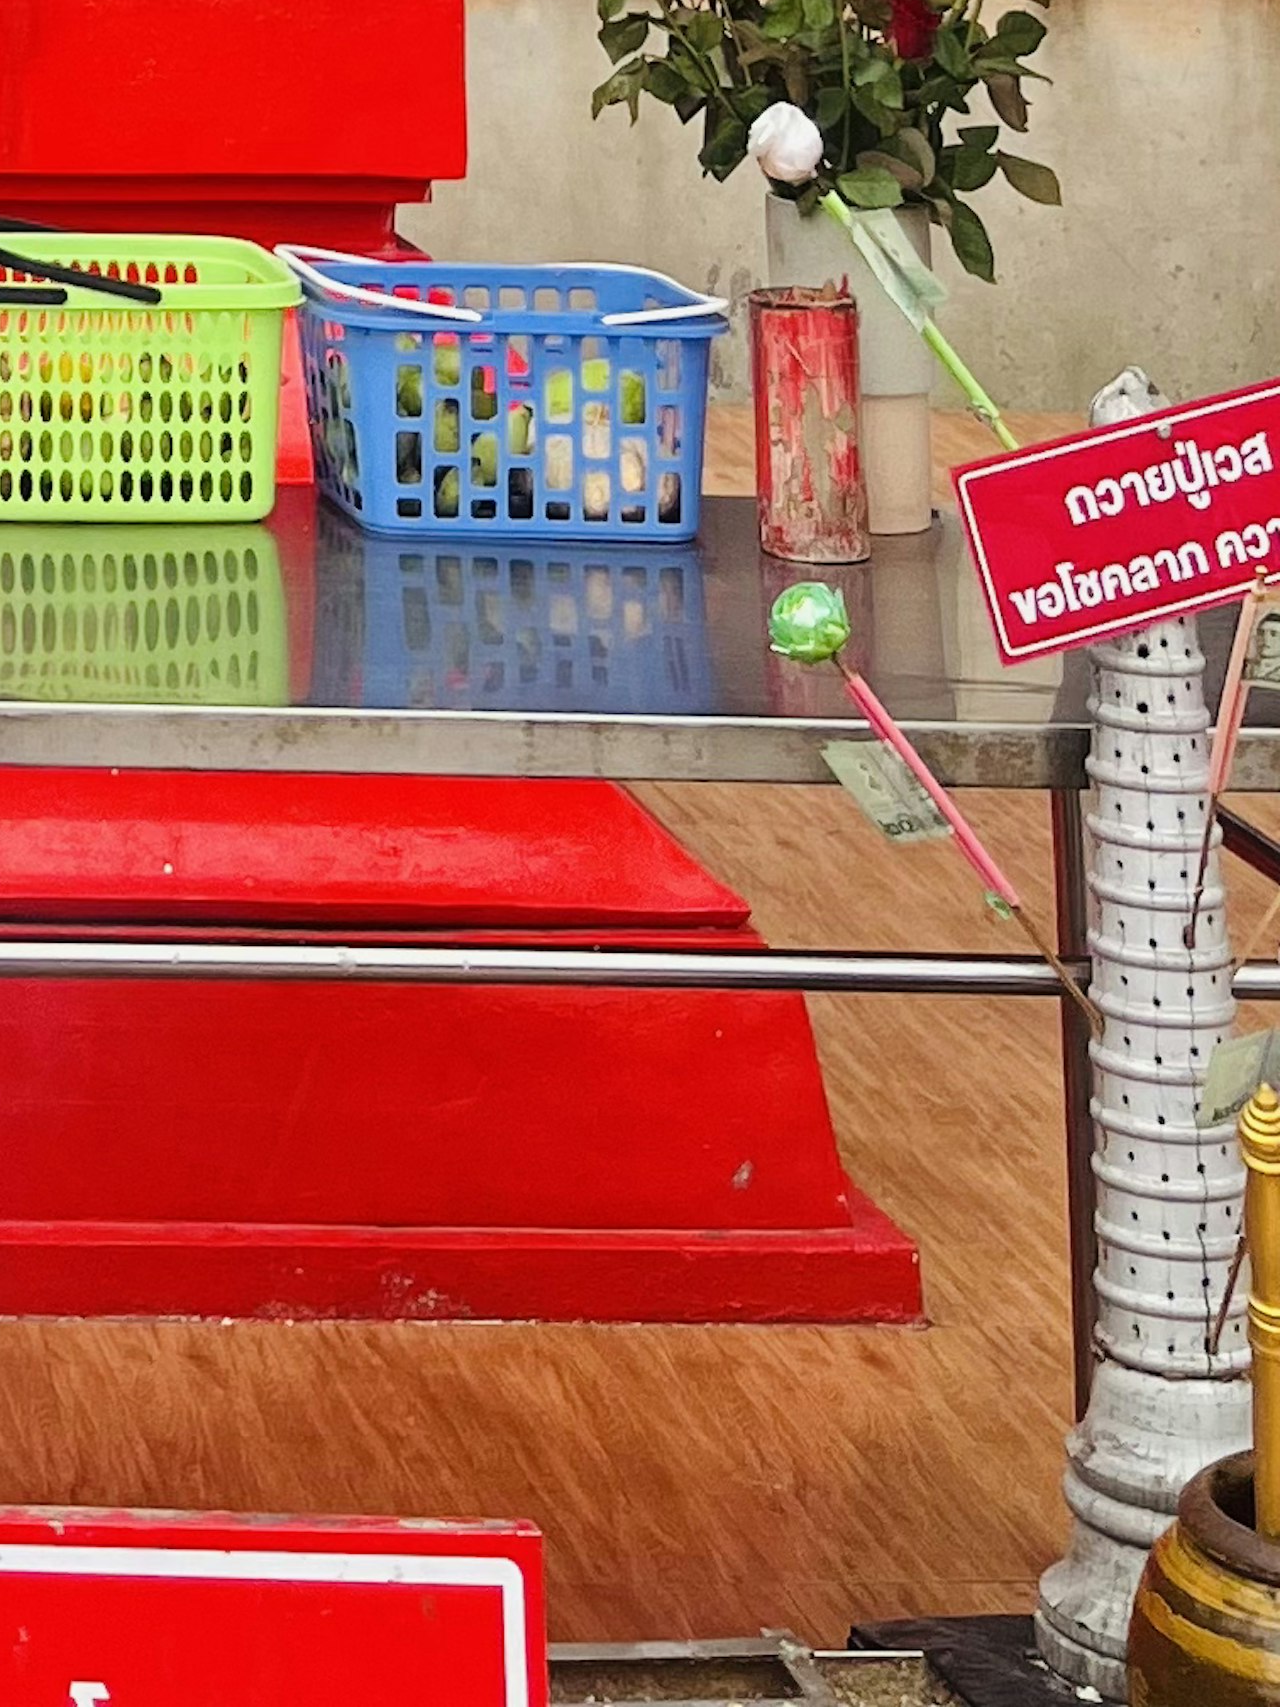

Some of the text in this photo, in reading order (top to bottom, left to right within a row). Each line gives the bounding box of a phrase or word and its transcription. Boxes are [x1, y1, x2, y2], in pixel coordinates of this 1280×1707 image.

[1064, 431, 1274, 526] ถวายปู่เวส
[1008, 541, 1211, 625] ขอโชคลาภ
